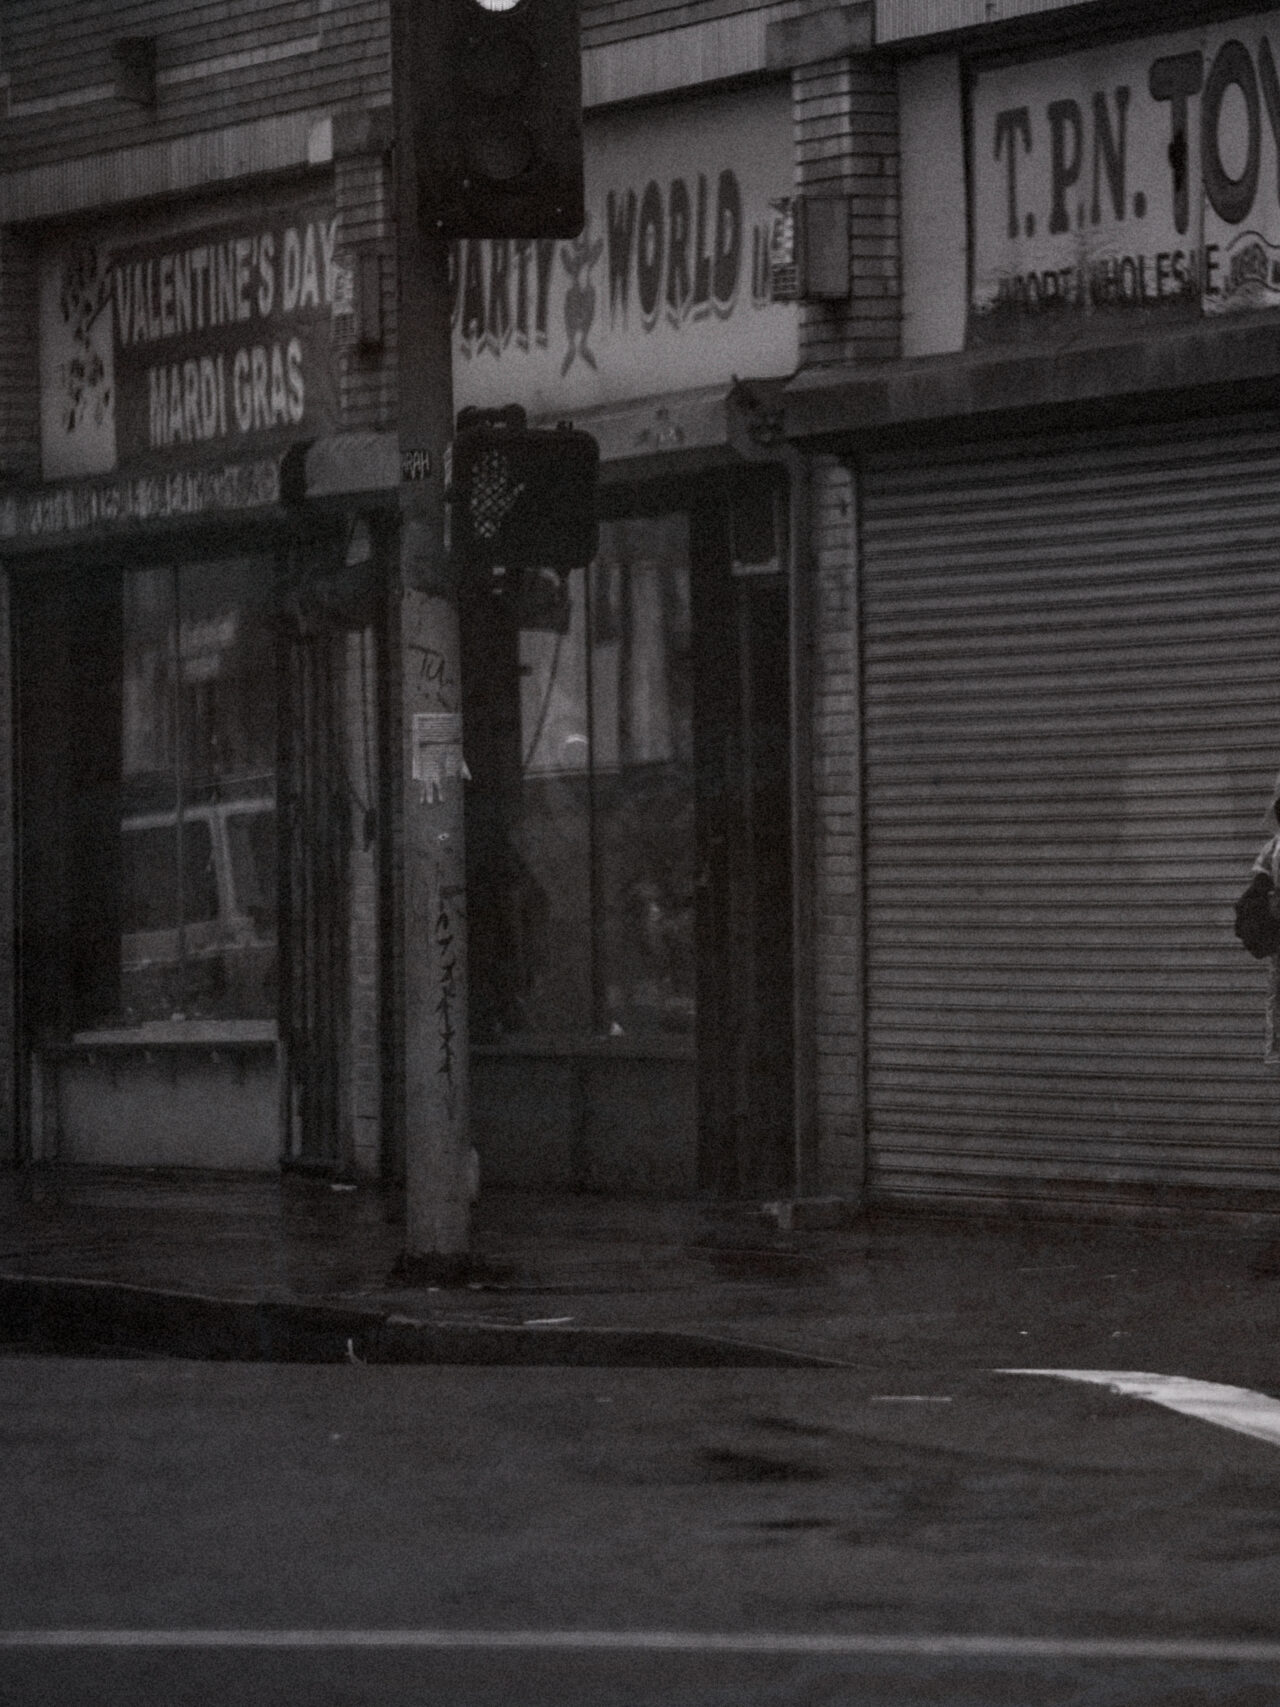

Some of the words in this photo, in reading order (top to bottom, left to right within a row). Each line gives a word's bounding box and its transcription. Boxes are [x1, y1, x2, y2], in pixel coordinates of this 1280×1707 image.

[994, 86, 1147, 238] T.P.N.
[116, 234, 275, 347] VALENTINE'S
[283, 215, 343, 313] DAY
[606, 169, 742, 330] WORLD
[149, 356, 227, 449] MARDI
[234, 339, 304, 434] GRAS
